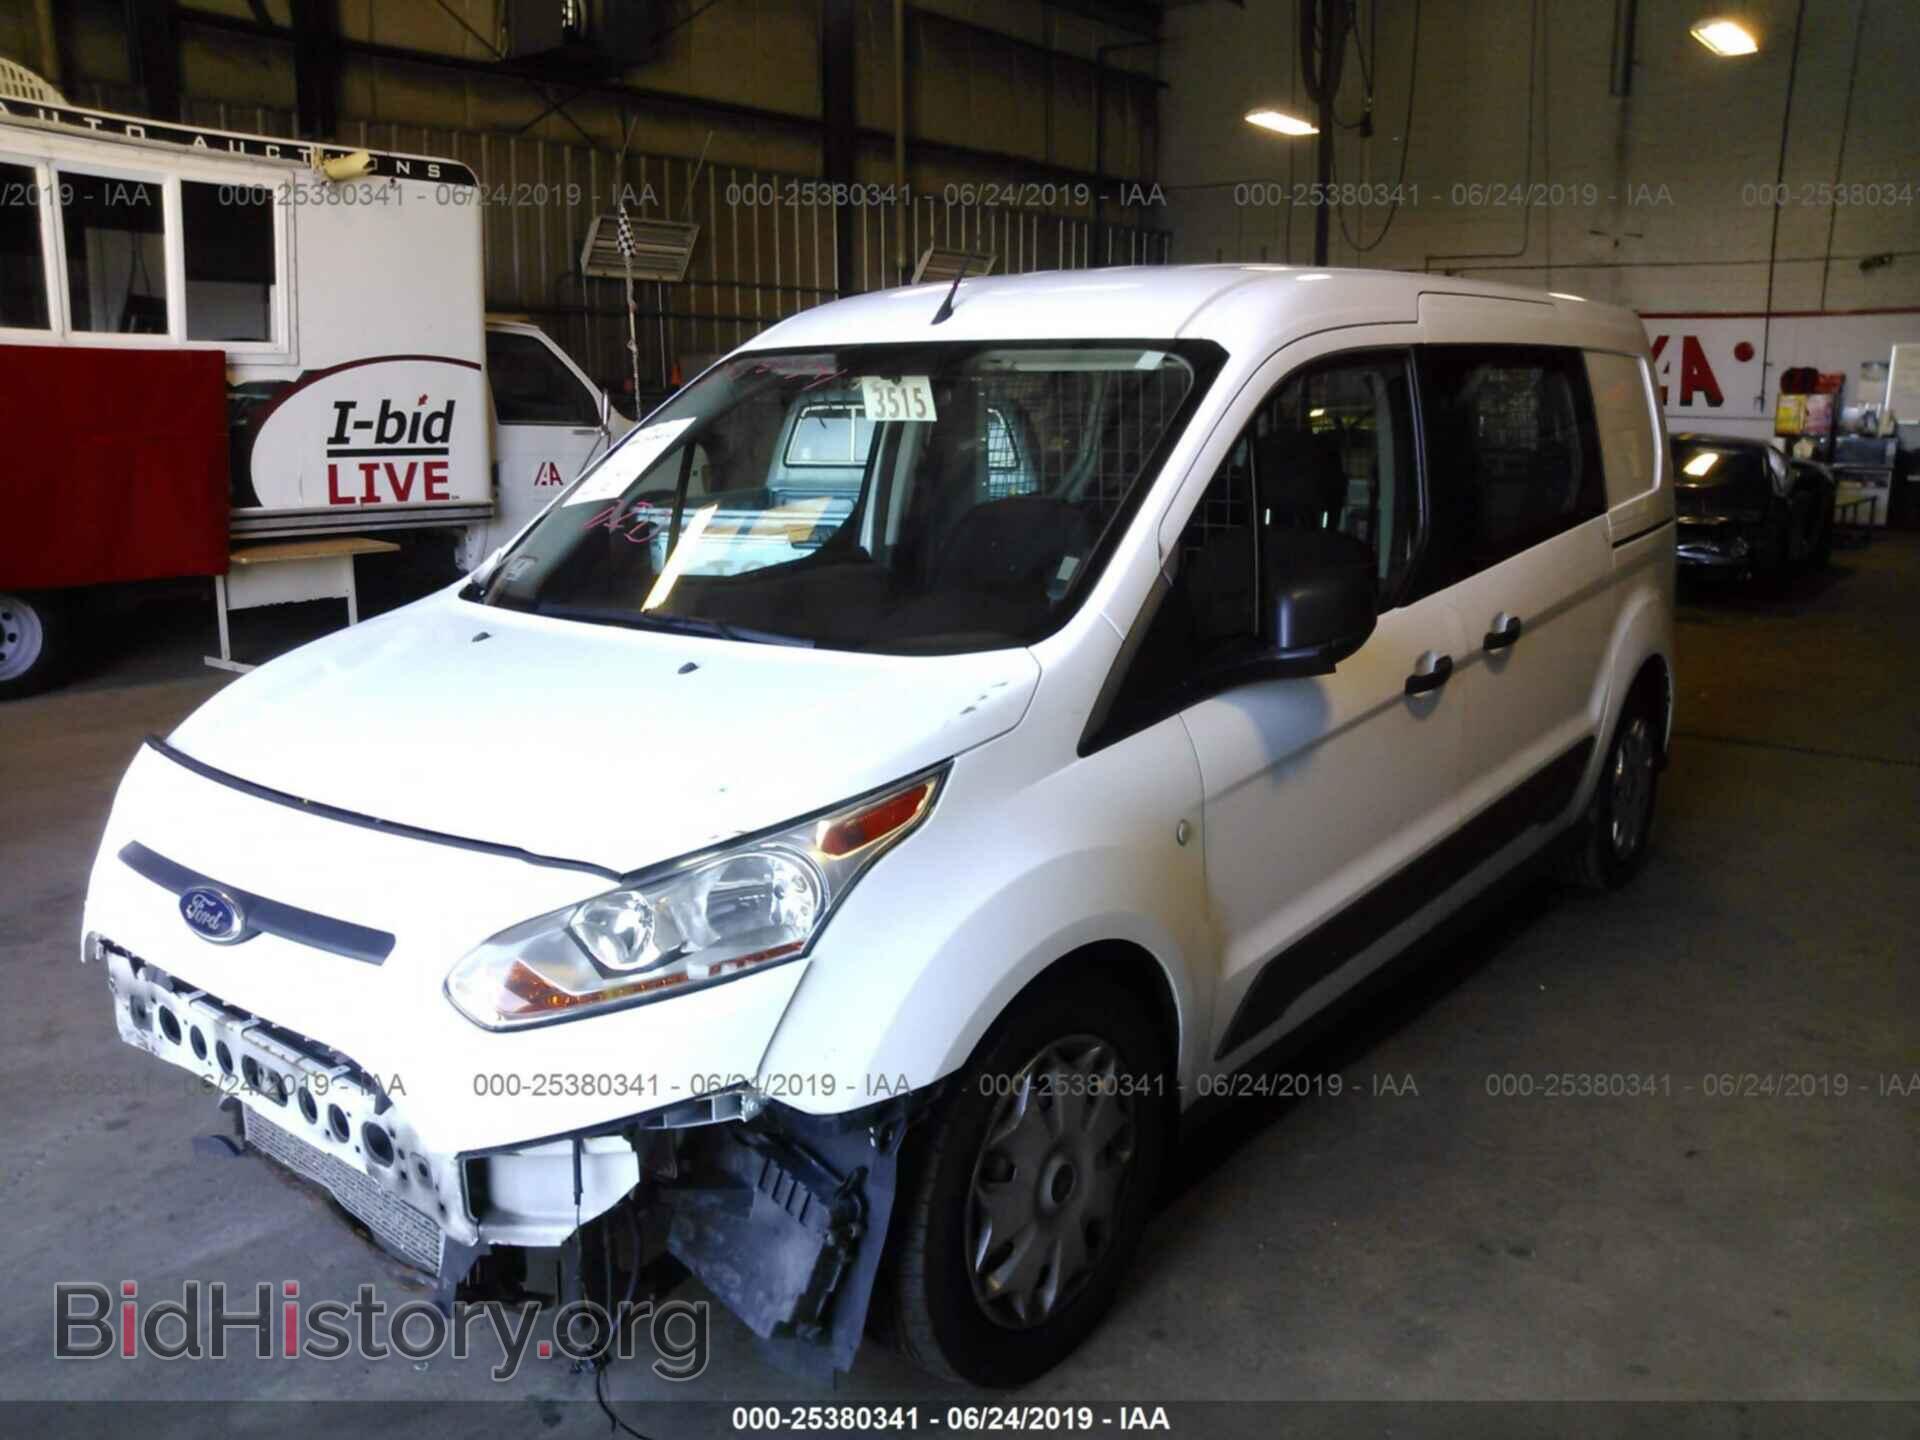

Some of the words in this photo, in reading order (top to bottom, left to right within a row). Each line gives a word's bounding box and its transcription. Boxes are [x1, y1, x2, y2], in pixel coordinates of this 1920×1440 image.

[193, 136, 441, 178] AUCTONS
[326, 394, 456, 446] I-bid
[872, 382, 927, 419] 3515
[328, 461, 450, 505] LIVE
[185, 893, 224, 930] Ford
